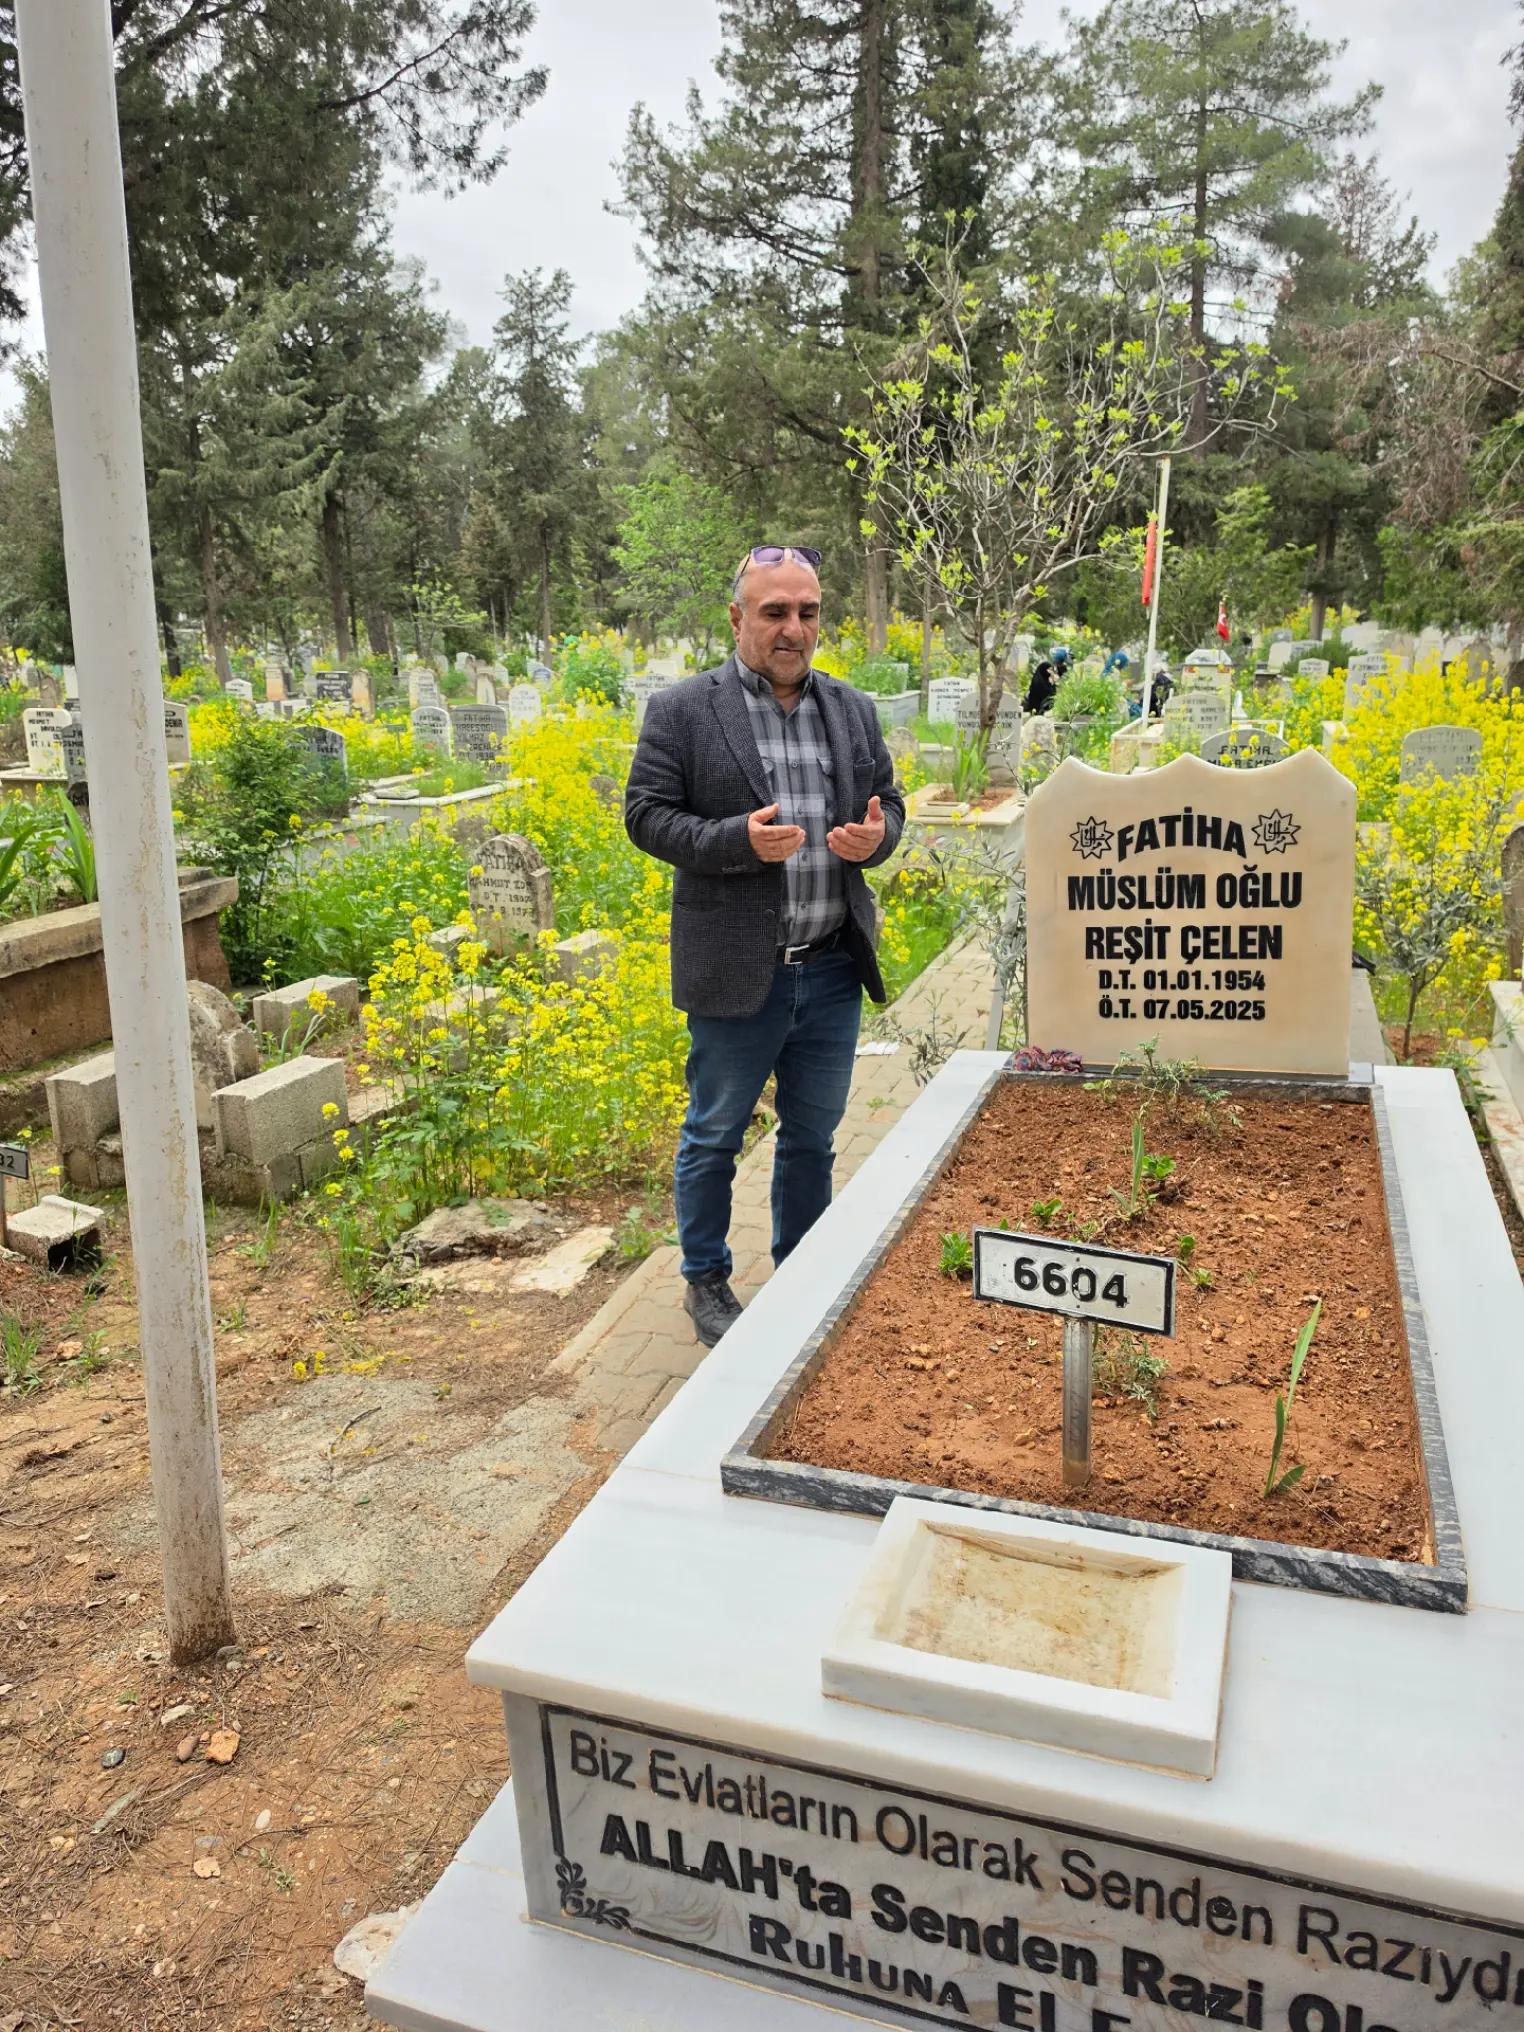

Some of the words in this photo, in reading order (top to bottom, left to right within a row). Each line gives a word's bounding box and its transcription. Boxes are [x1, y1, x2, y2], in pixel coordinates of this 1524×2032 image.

[1118, 807, 1247, 862] FATİHA
[1068, 867, 1206, 910] MÜSLÜM
[1216, 864, 1302, 908] OĞLU
[1085, 918, 1171, 964] REŞİT
[1181, 925, 1282, 964] ÇELEN
[1099, 970, 1136, 990] D.T.
[1143, 970, 1265, 990] 01.01.1954
[1099, 995, 1136, 1018] Ö.T.
[1143, 999, 1265, 1020] 07.05.2025
[1014, 1257, 1128, 1308] 6604
[570, 1729, 636, 1789] Biz
[649, 1749, 858, 1842] Evlatların
[876, 1806, 1044, 1890] Olarak
[1061, 1849, 1273, 1946] Senden
[600, 1814, 852, 1919] ALLAH'ta
[870, 1884, 1097, 1986] Senden
[1123, 1946, 1263, 2030] Razi
